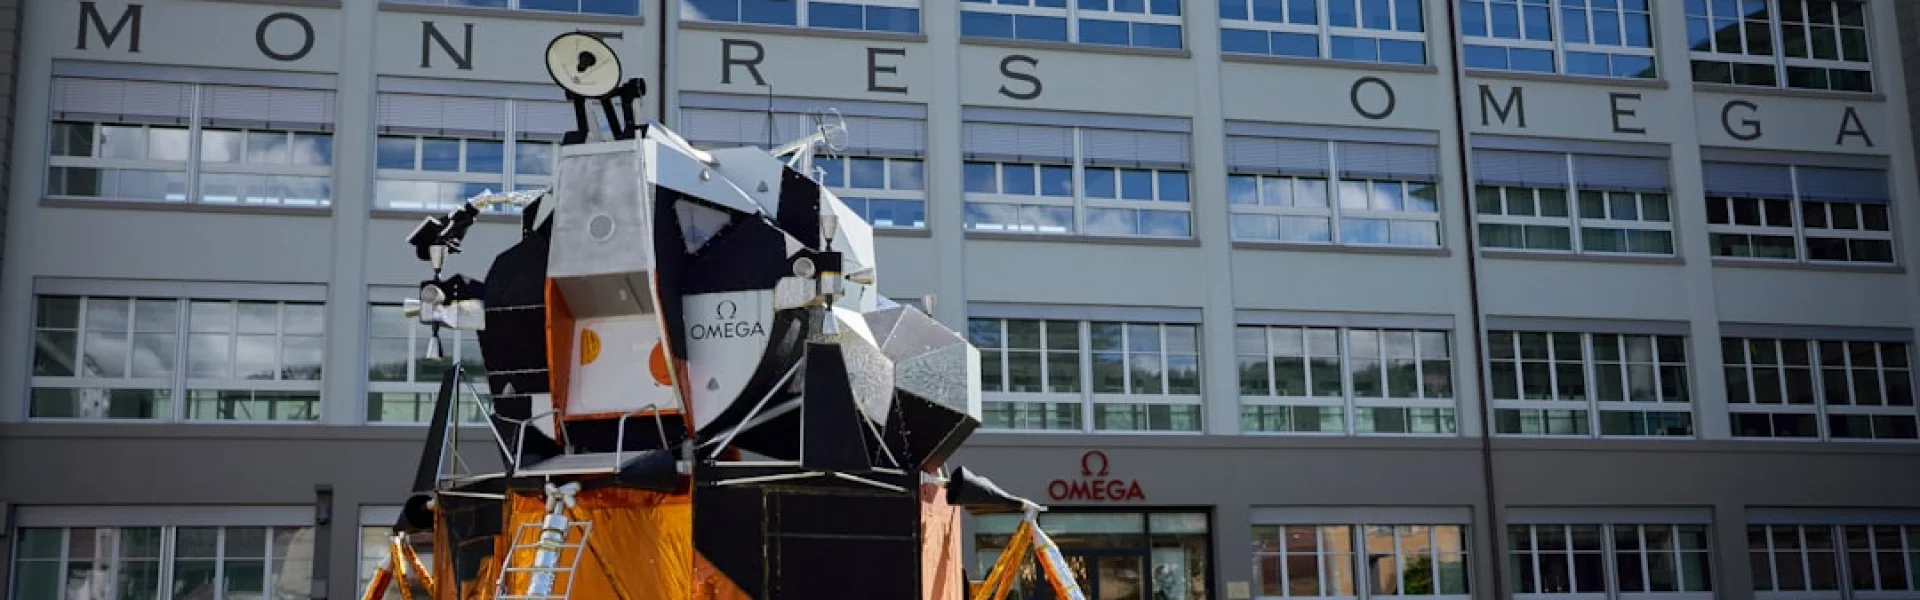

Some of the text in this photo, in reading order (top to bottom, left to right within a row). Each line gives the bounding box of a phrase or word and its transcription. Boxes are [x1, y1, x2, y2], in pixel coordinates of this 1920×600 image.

[75, 1, 1875, 147] MONRES OMEGA
[690, 320, 766, 340] OMEGA
[1048, 479, 1146, 500] OMEGA
